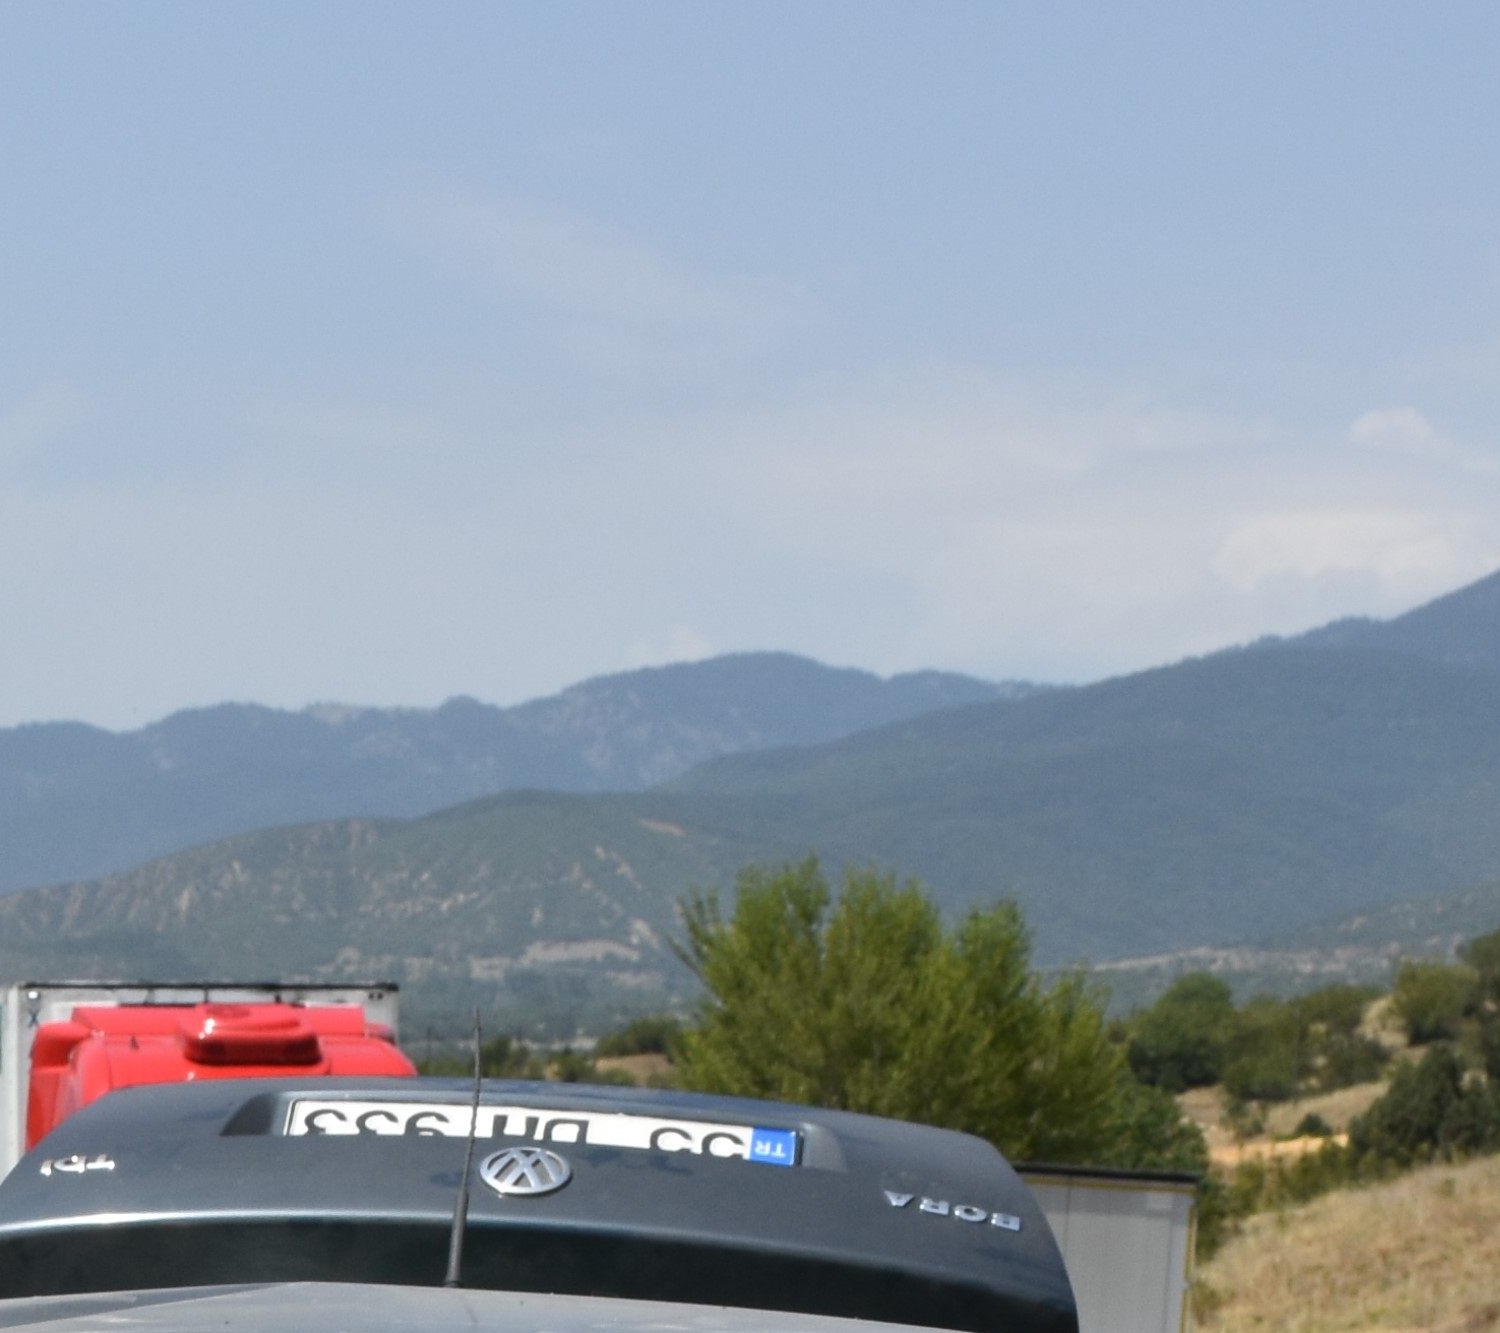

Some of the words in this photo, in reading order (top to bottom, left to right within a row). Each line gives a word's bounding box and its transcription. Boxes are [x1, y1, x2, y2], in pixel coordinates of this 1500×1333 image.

[755, 1140, 787, 1158] TR
[40, 1153, 116, 1177] TDI
[884, 1190, 1021, 1232] BORA
